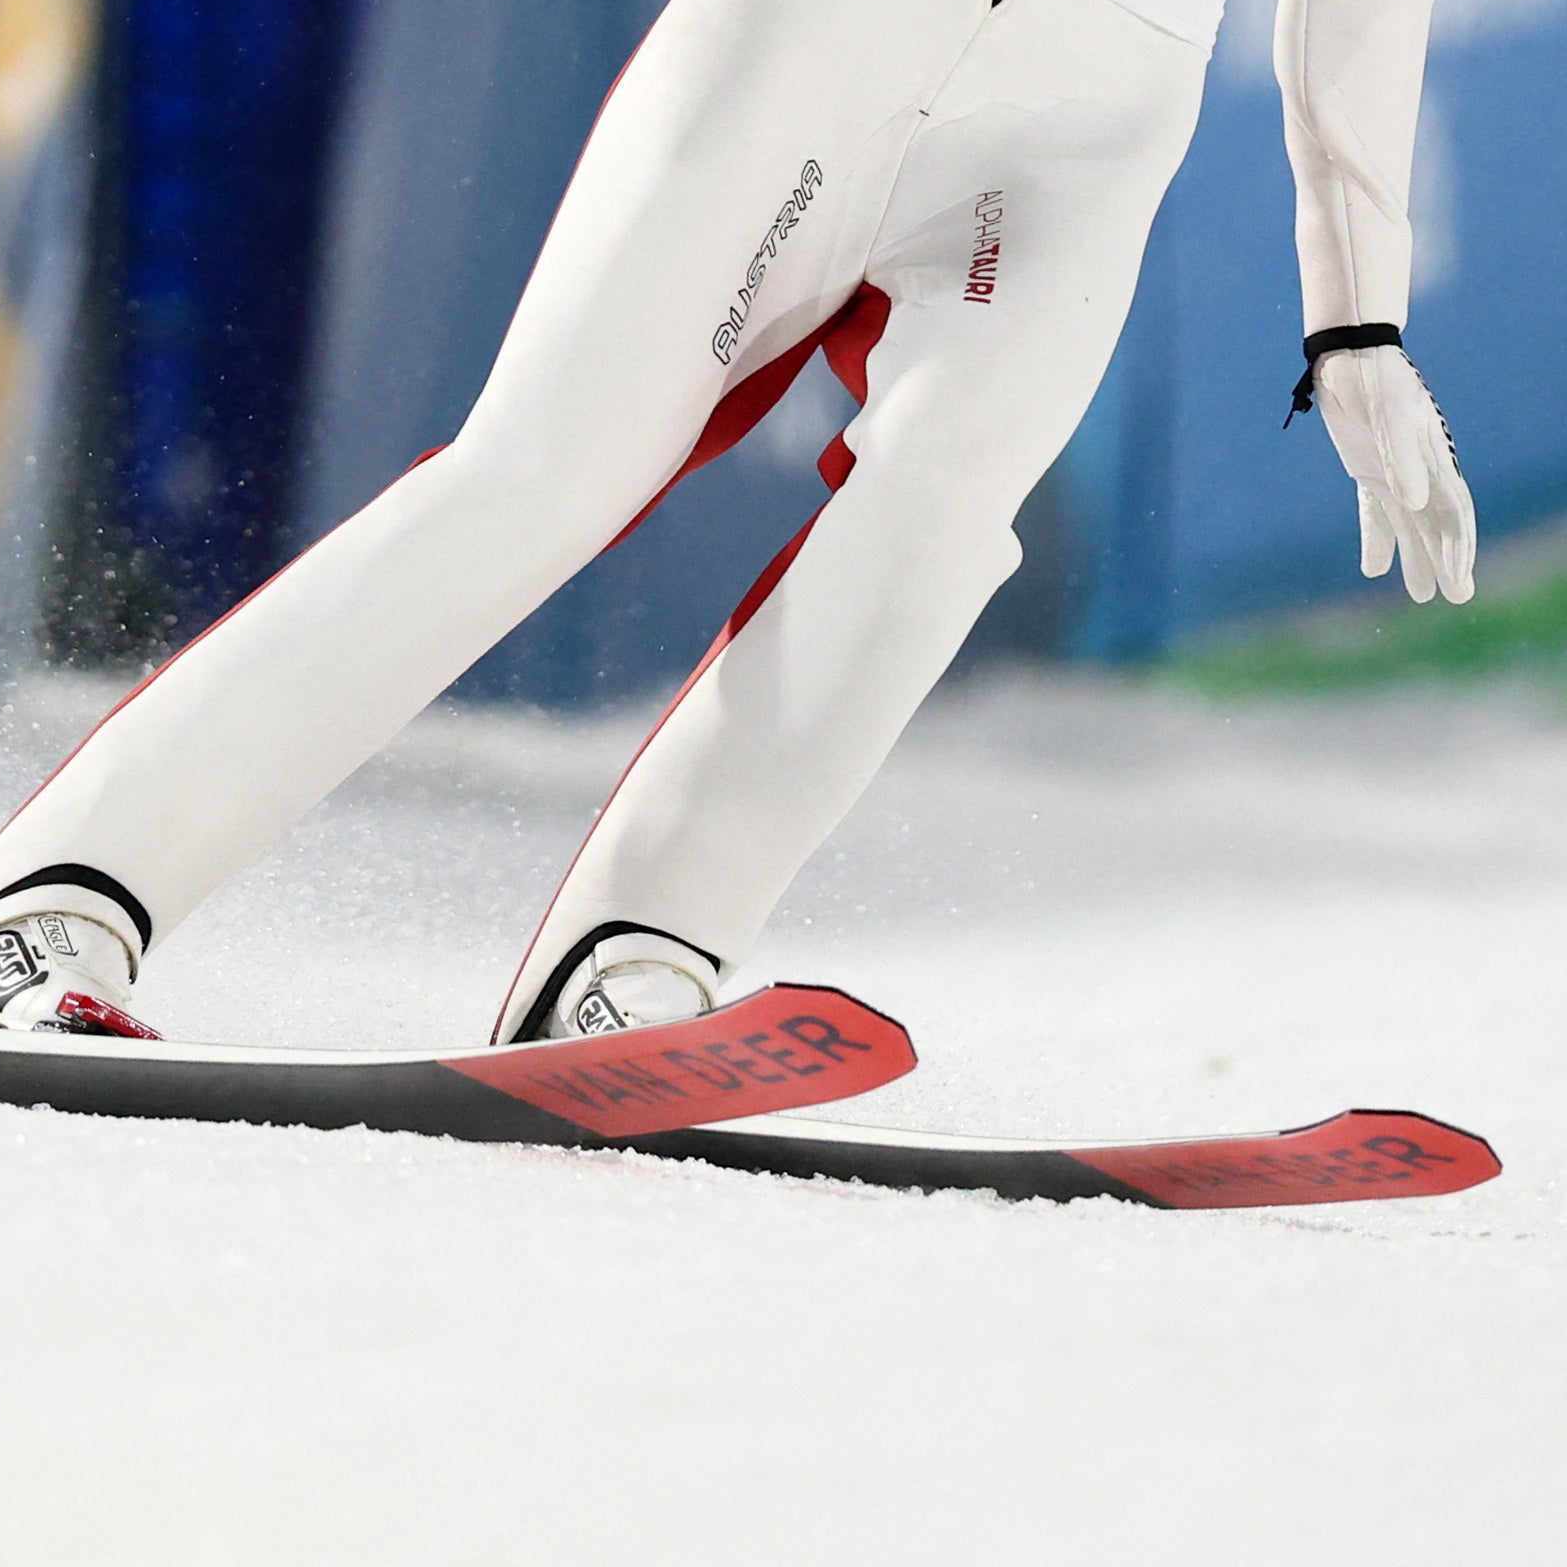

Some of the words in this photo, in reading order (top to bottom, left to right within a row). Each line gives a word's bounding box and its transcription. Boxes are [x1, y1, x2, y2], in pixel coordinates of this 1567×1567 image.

[712, 158, 824, 365] AUSTRIA
[962, 189, 1004, 305] ALPHATAURI
[43, 916, 68, 952] EAGLE
[527, 1058, 691, 1113] VAN
[661, 1014, 873, 1091] DEER
